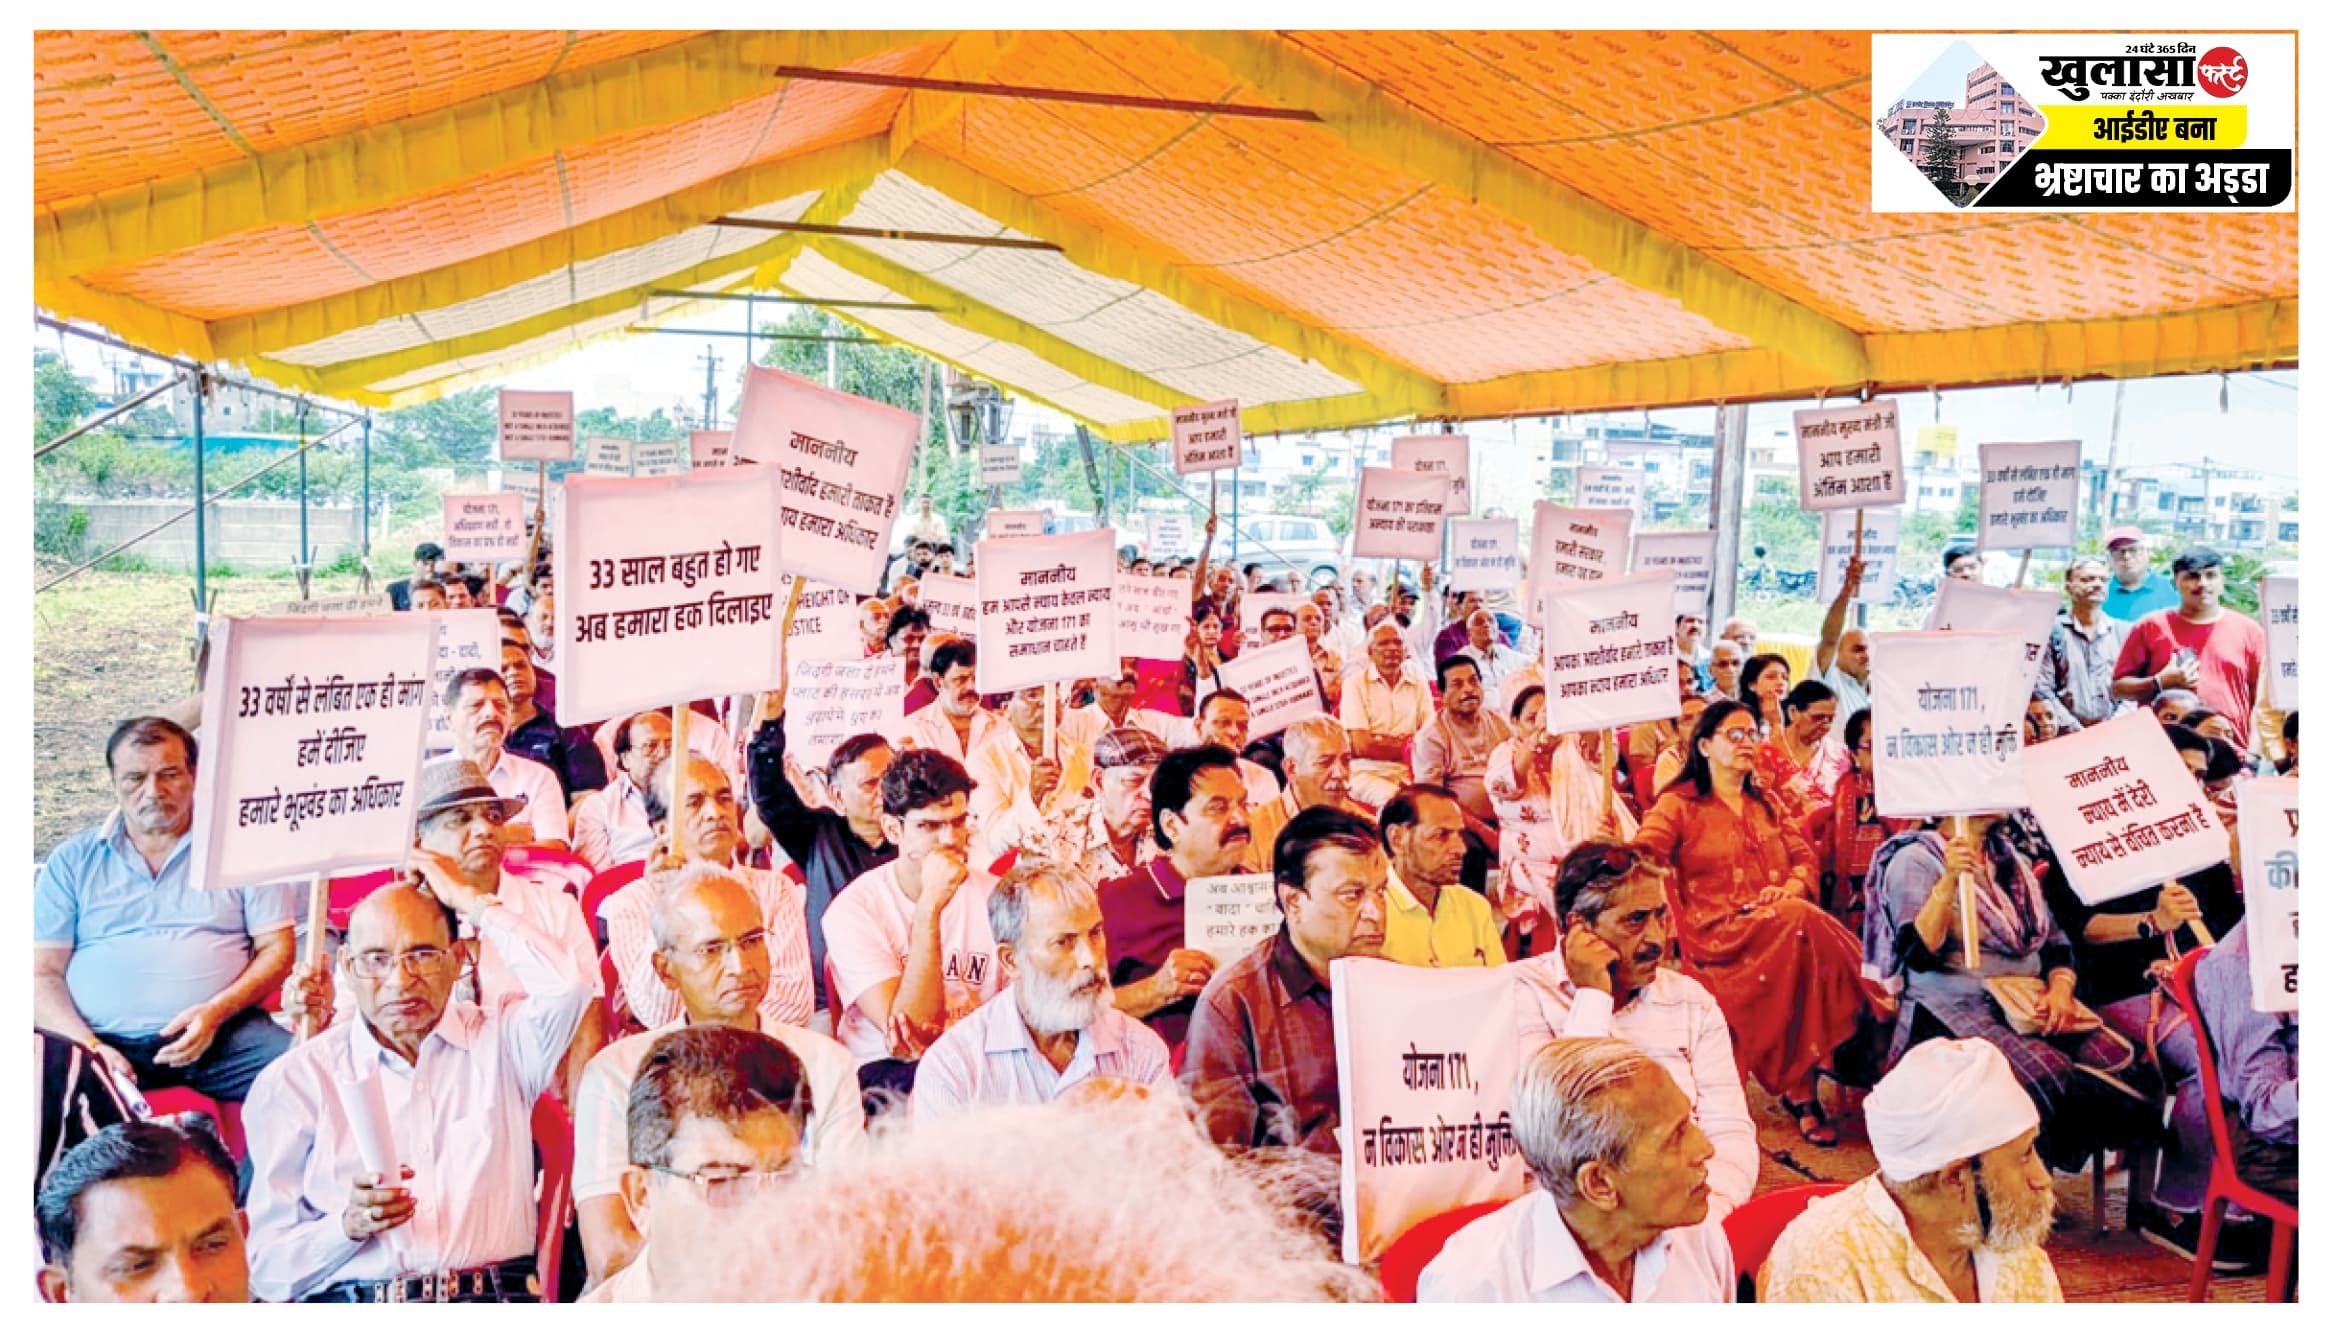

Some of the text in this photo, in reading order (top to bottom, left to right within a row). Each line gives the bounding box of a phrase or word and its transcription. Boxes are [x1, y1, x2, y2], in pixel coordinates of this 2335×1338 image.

[1800, 418, 1838, 440] माननीय
[1839, 418, 1862, 440] मुख्य
[789, 430, 859, 468] माननीय
[1820, 442, 1881, 468] आप हमारी
[1813, 475, 1847, 498] अंतिम
[1850, 475, 1880, 494] आशा
[800, 510, 879, 551] हमारा अधिकार
[590, 539, 761, 590] 33 साल बहुत हो गए
[1019, 562, 1077, 586] माननीय
[575, 590, 773, 643] अब हमारा हक दिलाइए
[981, 598, 1000, 616] हम
[1002, 592, 1032, 614] आपसे
[1033, 595, 1059, 611] न्याय
[1087, 586, 1113, 604] न्याय
[788, 617, 823, 636] STICE
[1026, 615, 1060, 634] योजना
[1060, 614, 1077, 631] 171
[1077, 612, 1091, 628] का
[1589, 610, 1639, 634] माननीय
[1009, 639, 1051, 659] समाधान
[1052, 634, 1079, 654] चाहते
[238, 686, 261, 717] 33
[265, 673, 295, 717] वर्षों
[295, 676, 311, 715] से
[313, 674, 354, 713] लंबित
[355, 682, 379, 711] एक
[380, 672, 396, 708] ही
[398, 672, 425, 707] मांग
[1917, 681, 1979, 712] योजना 171
[297, 726, 367, 767] हमें दीजिए
[1886, 734, 1898, 759] न
[1901, 726, 1938, 759] विकास
[1966, 733, 1977, 755] न
[1979, 723, 1994, 755] ही
[2065, 755, 2131, 789] माननीय
[239, 775, 405, 831] हमारे भूखंड का अधिकार
[2078, 778, 2158, 825] न्याय में देरी
[2071, 802, 2211, 869] न्याय से वंचित करना है
[1402, 1041, 1470, 1091] योजना 171
[1362, 1127, 1377, 1168] न
[1379, 1114, 1427, 1167] विकास
[1455, 1127, 1467, 1161] न
[1469, 1111, 1483, 1160] ही
